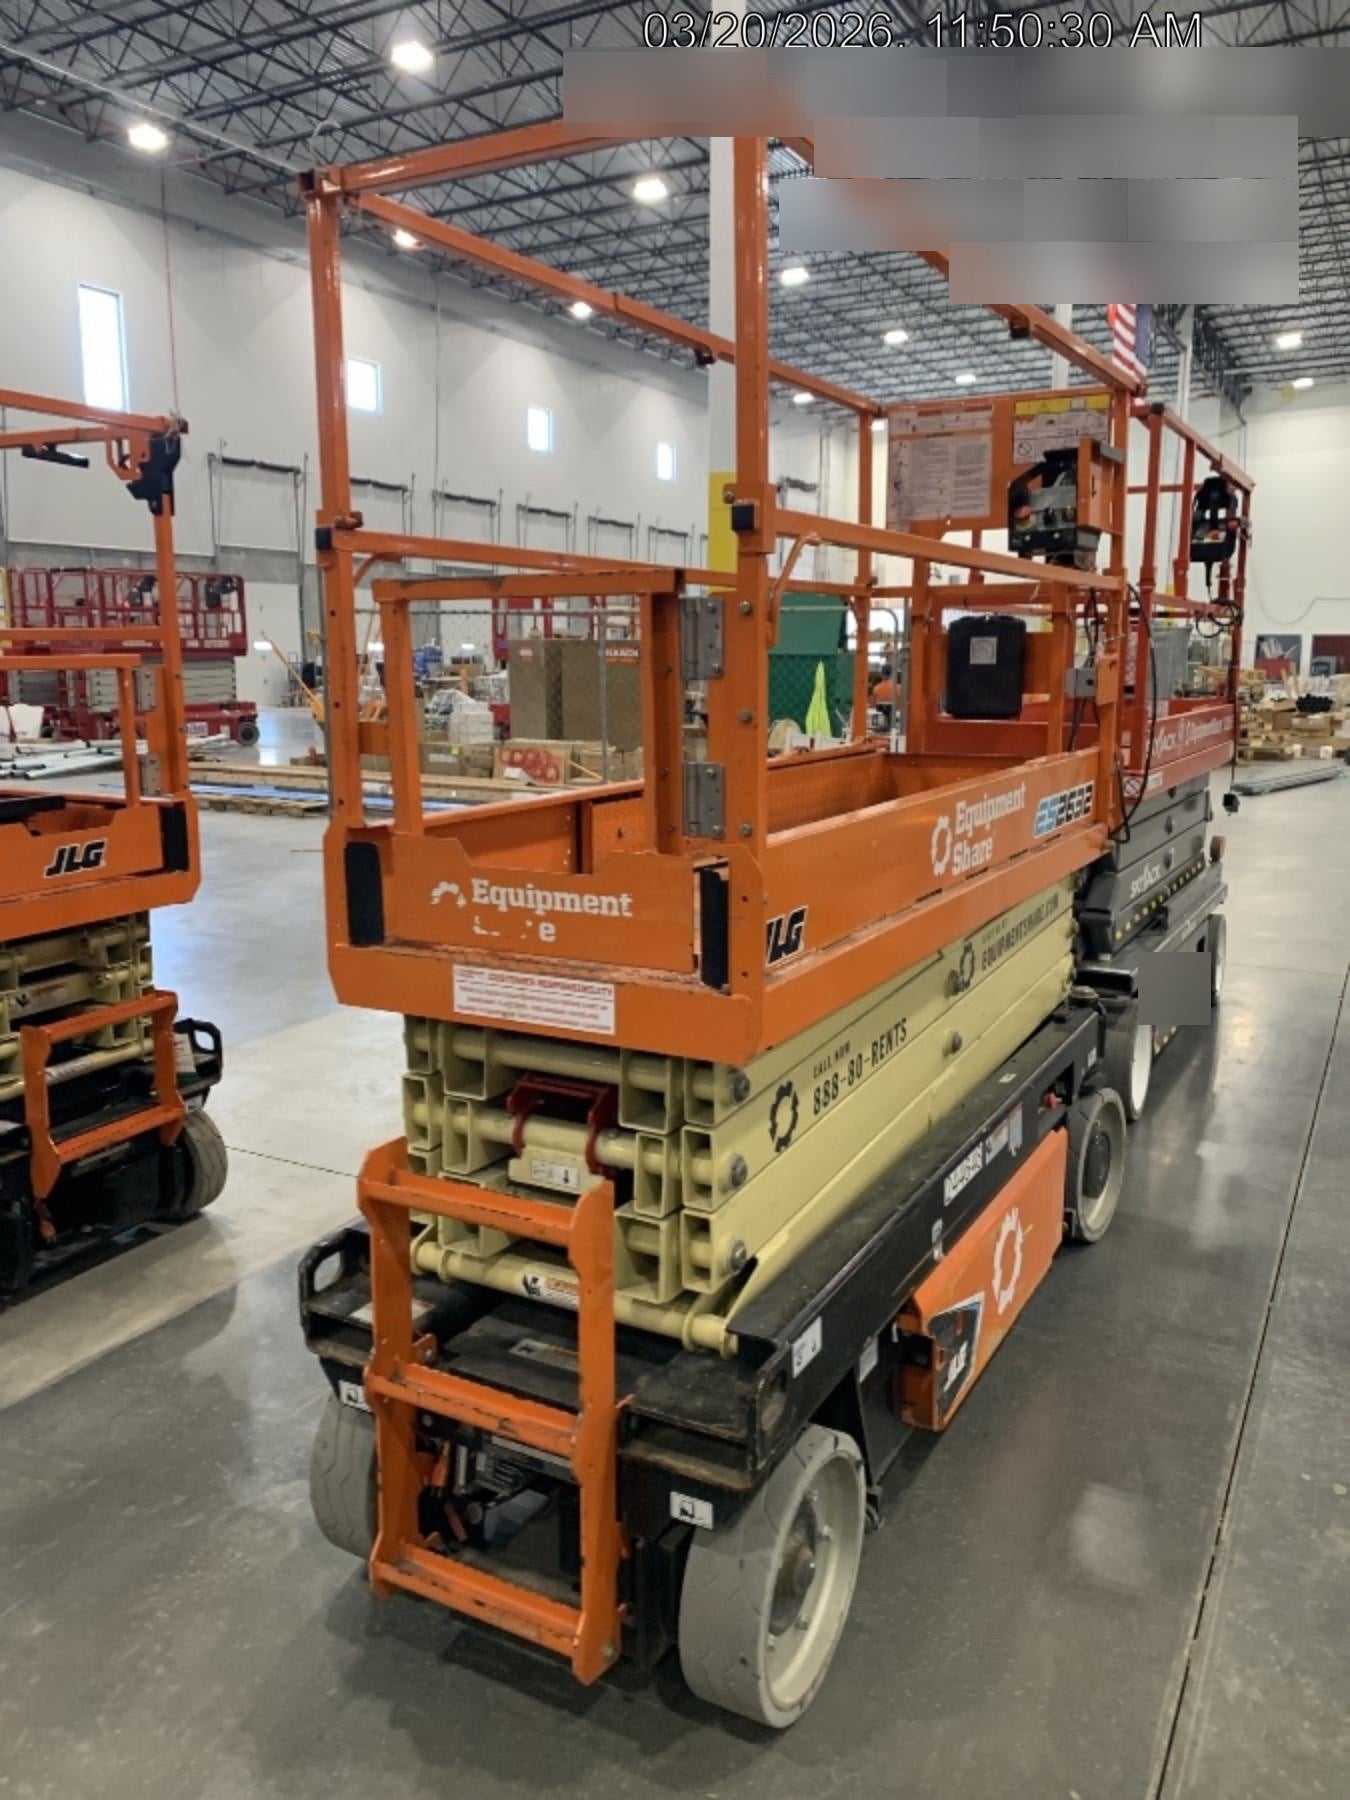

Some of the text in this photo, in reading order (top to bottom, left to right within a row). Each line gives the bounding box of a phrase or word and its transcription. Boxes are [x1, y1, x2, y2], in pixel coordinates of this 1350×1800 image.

[954, 782, 1027, 837] Equipment
[44, 838, 106, 878] JLG
[951, 833, 995, 876] Share
[471, 878, 633, 917] Equipment
[812, 1018, 909, 1116] 888-80-RENTS
[813, 1060, 833, 1079] CALL
